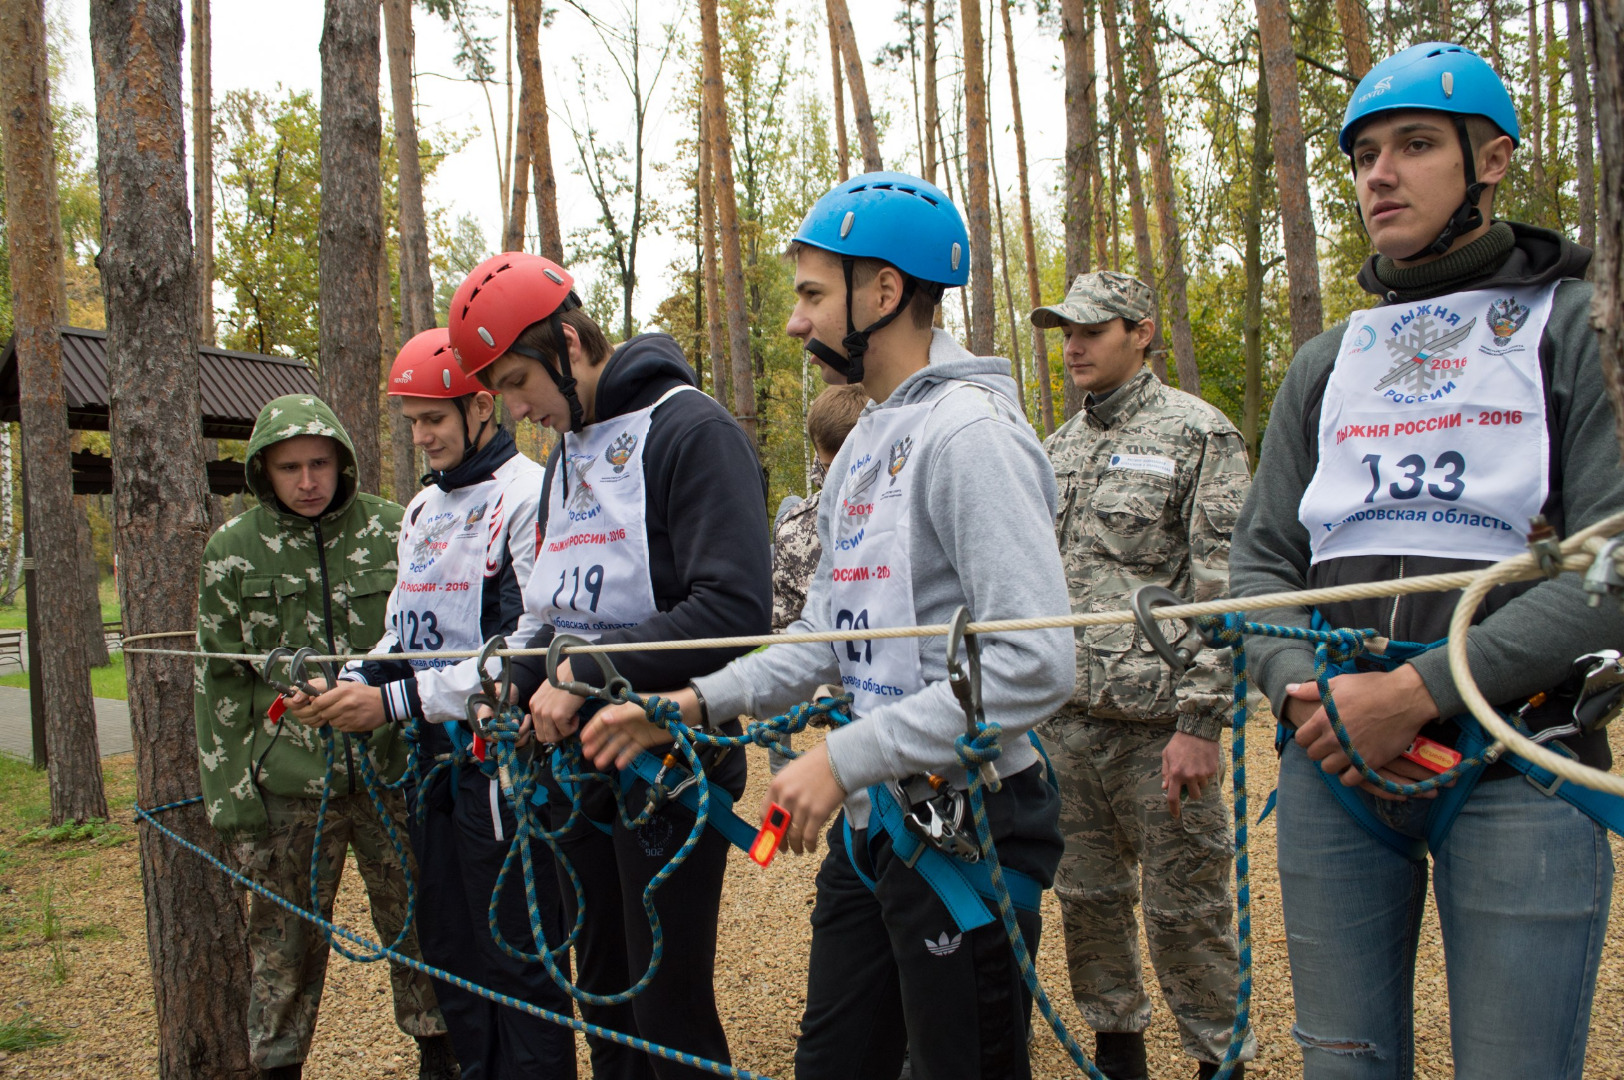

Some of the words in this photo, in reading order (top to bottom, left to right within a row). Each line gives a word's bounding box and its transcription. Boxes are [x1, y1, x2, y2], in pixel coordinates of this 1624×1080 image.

[1390, 304, 1461, 337] ЛЫЖНЯ
[1430, 356, 1467, 370] 2016
[1383, 380, 1456, 404] РОССИИ
[1336, 424, 1390, 446] ЛЫЖНЯ
[1394, 413, 1462, 436] РОССИИ
[1478, 410, 1523, 426] 2016
[1361, 450, 1466, 504] 133
[1432, 508, 1512, 531] область
[445, 582, 469, 592] 2016
[552, 564, 604, 613] 119
